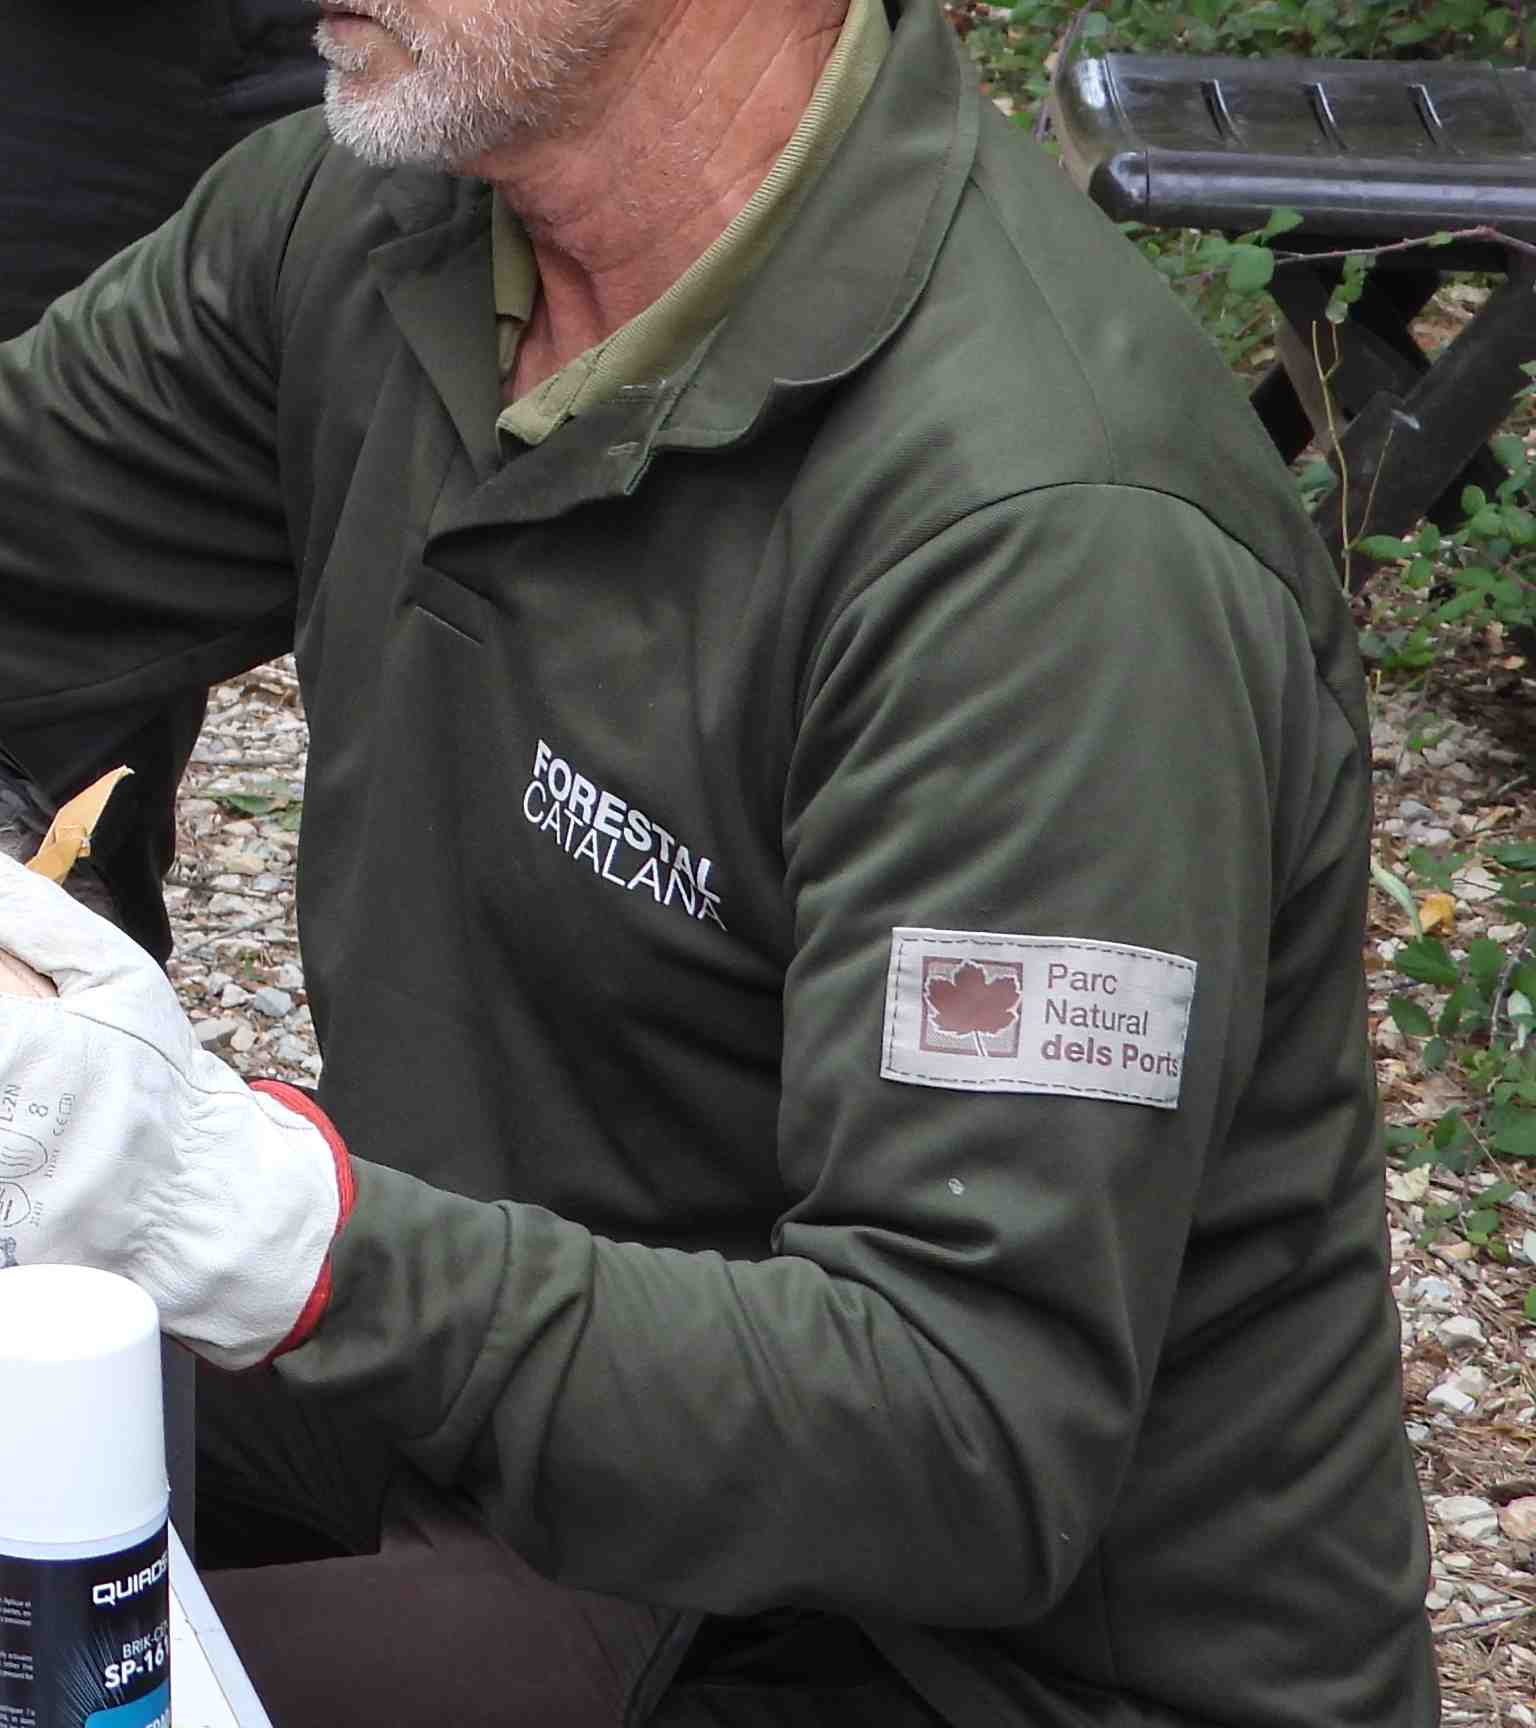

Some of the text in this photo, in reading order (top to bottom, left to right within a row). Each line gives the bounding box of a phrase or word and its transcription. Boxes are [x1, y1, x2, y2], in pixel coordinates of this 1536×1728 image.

[533, 739, 721, 904] FORESTAL
[523, 780, 727, 932] CATALANA
[1047, 963, 1119, 996] Parc
[1044, 998, 1149, 1036] Natural
[1040, 1034, 1179, 1077] dels Ports
[28, 1103, 49, 1119] 8
